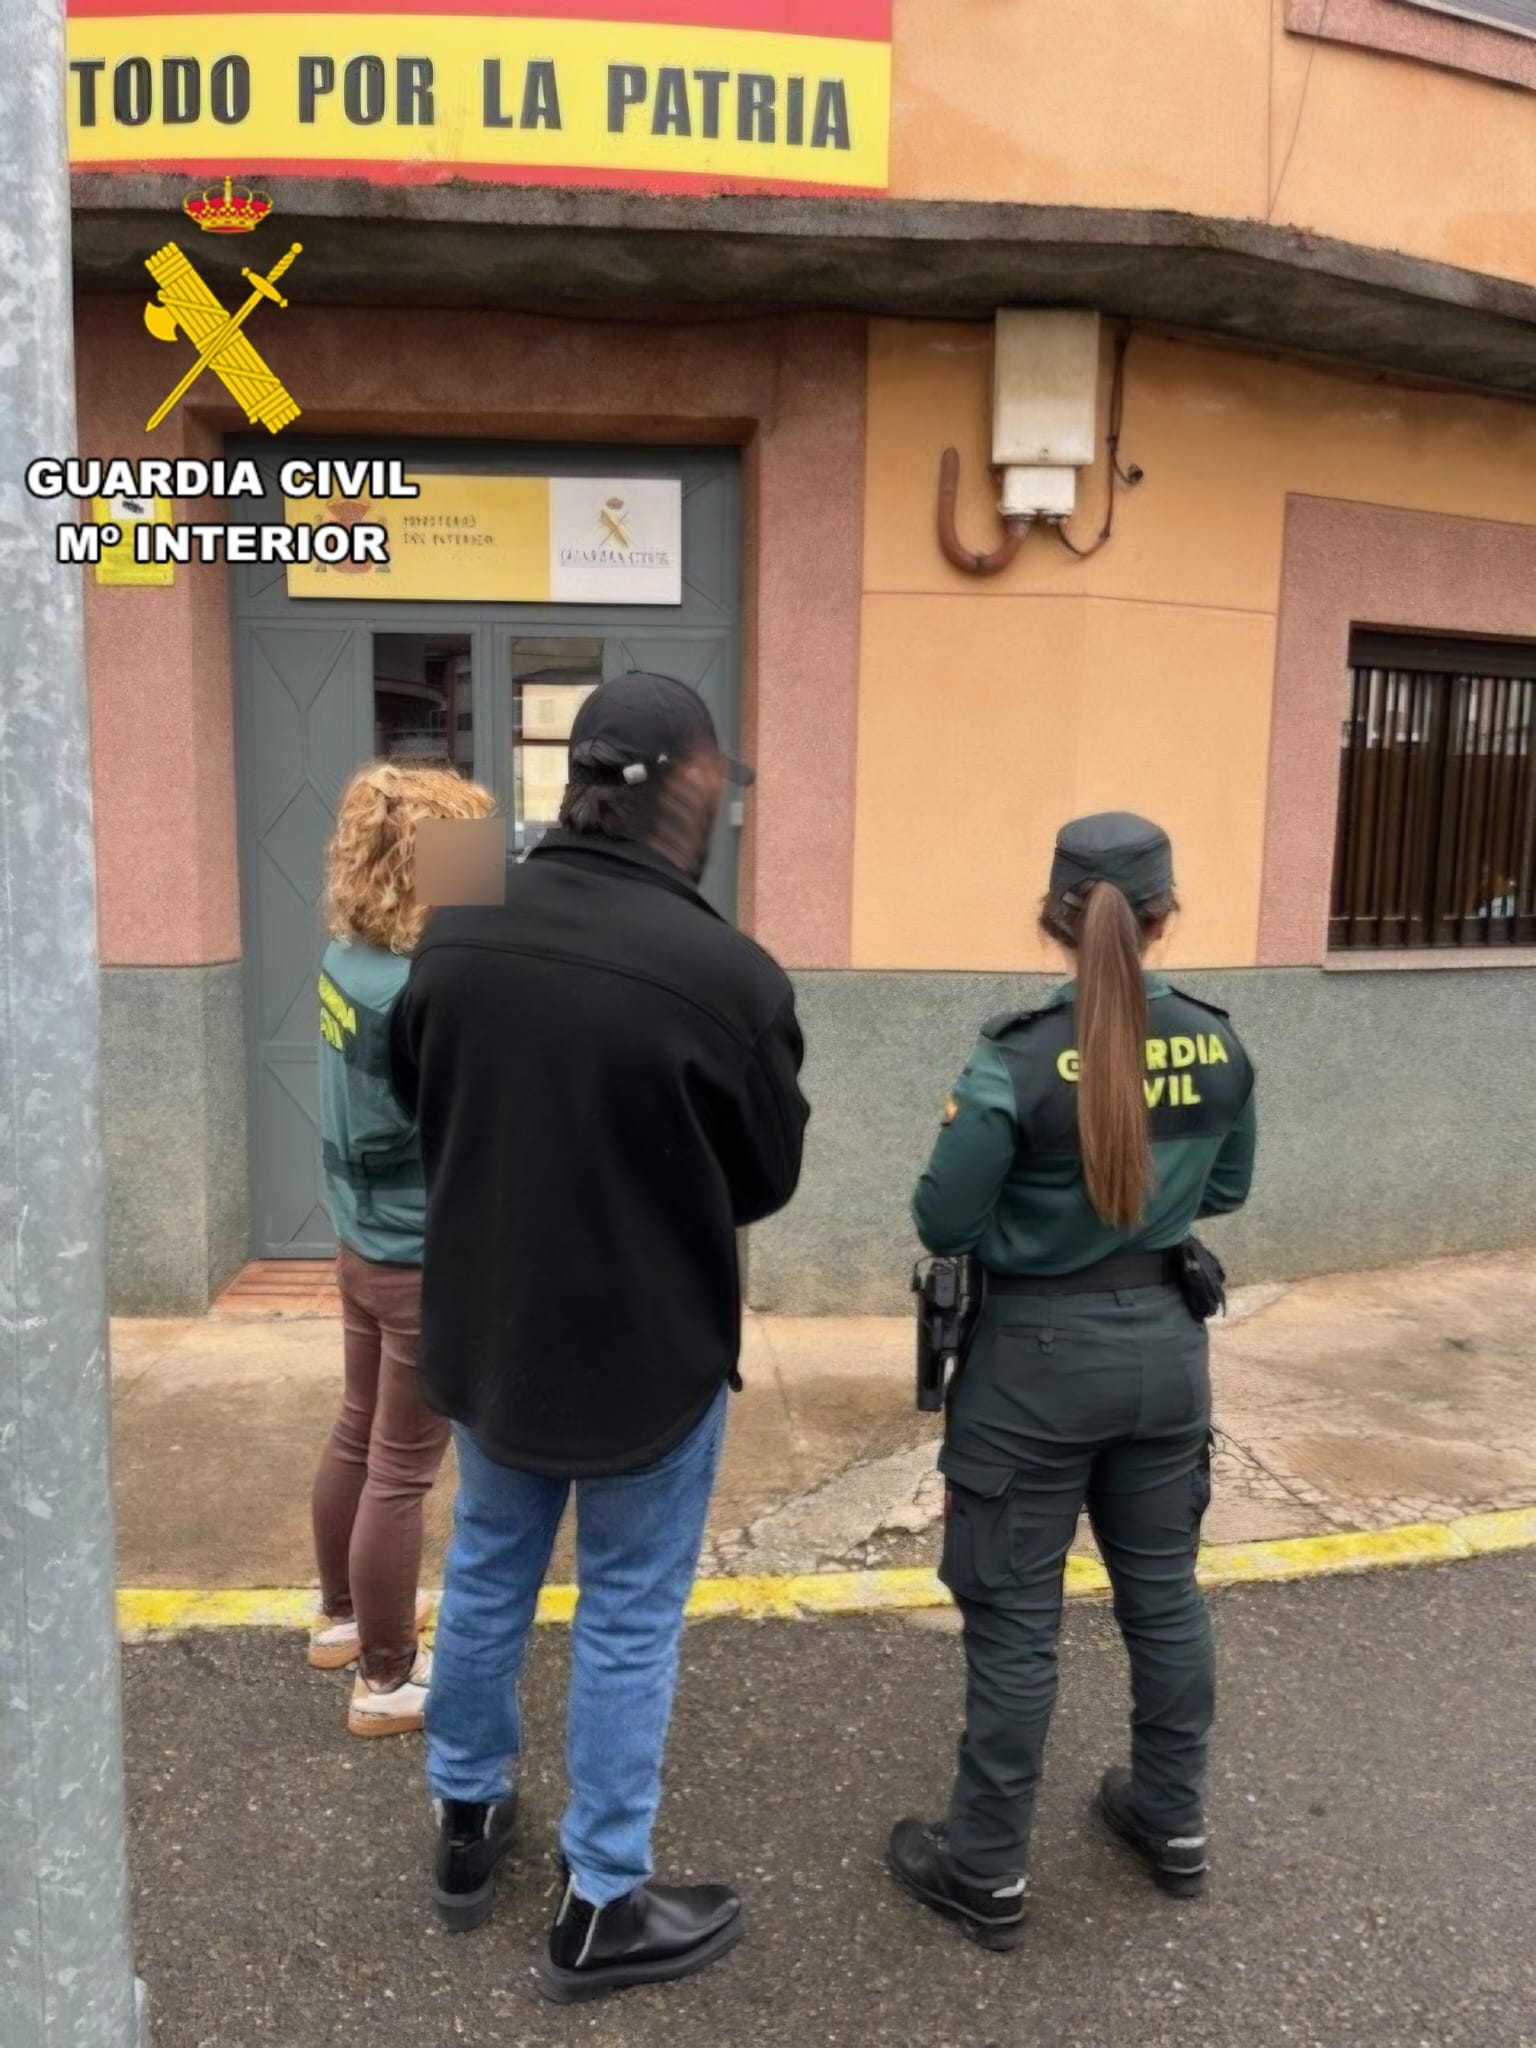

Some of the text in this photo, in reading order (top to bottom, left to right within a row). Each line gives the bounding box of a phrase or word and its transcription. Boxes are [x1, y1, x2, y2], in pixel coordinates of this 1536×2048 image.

[70, 54, 853, 151] TODO POR LA PATRIA
[1056, 1033, 1229, 1083] GRDIA
[1143, 1073, 1202, 1109] VIL
